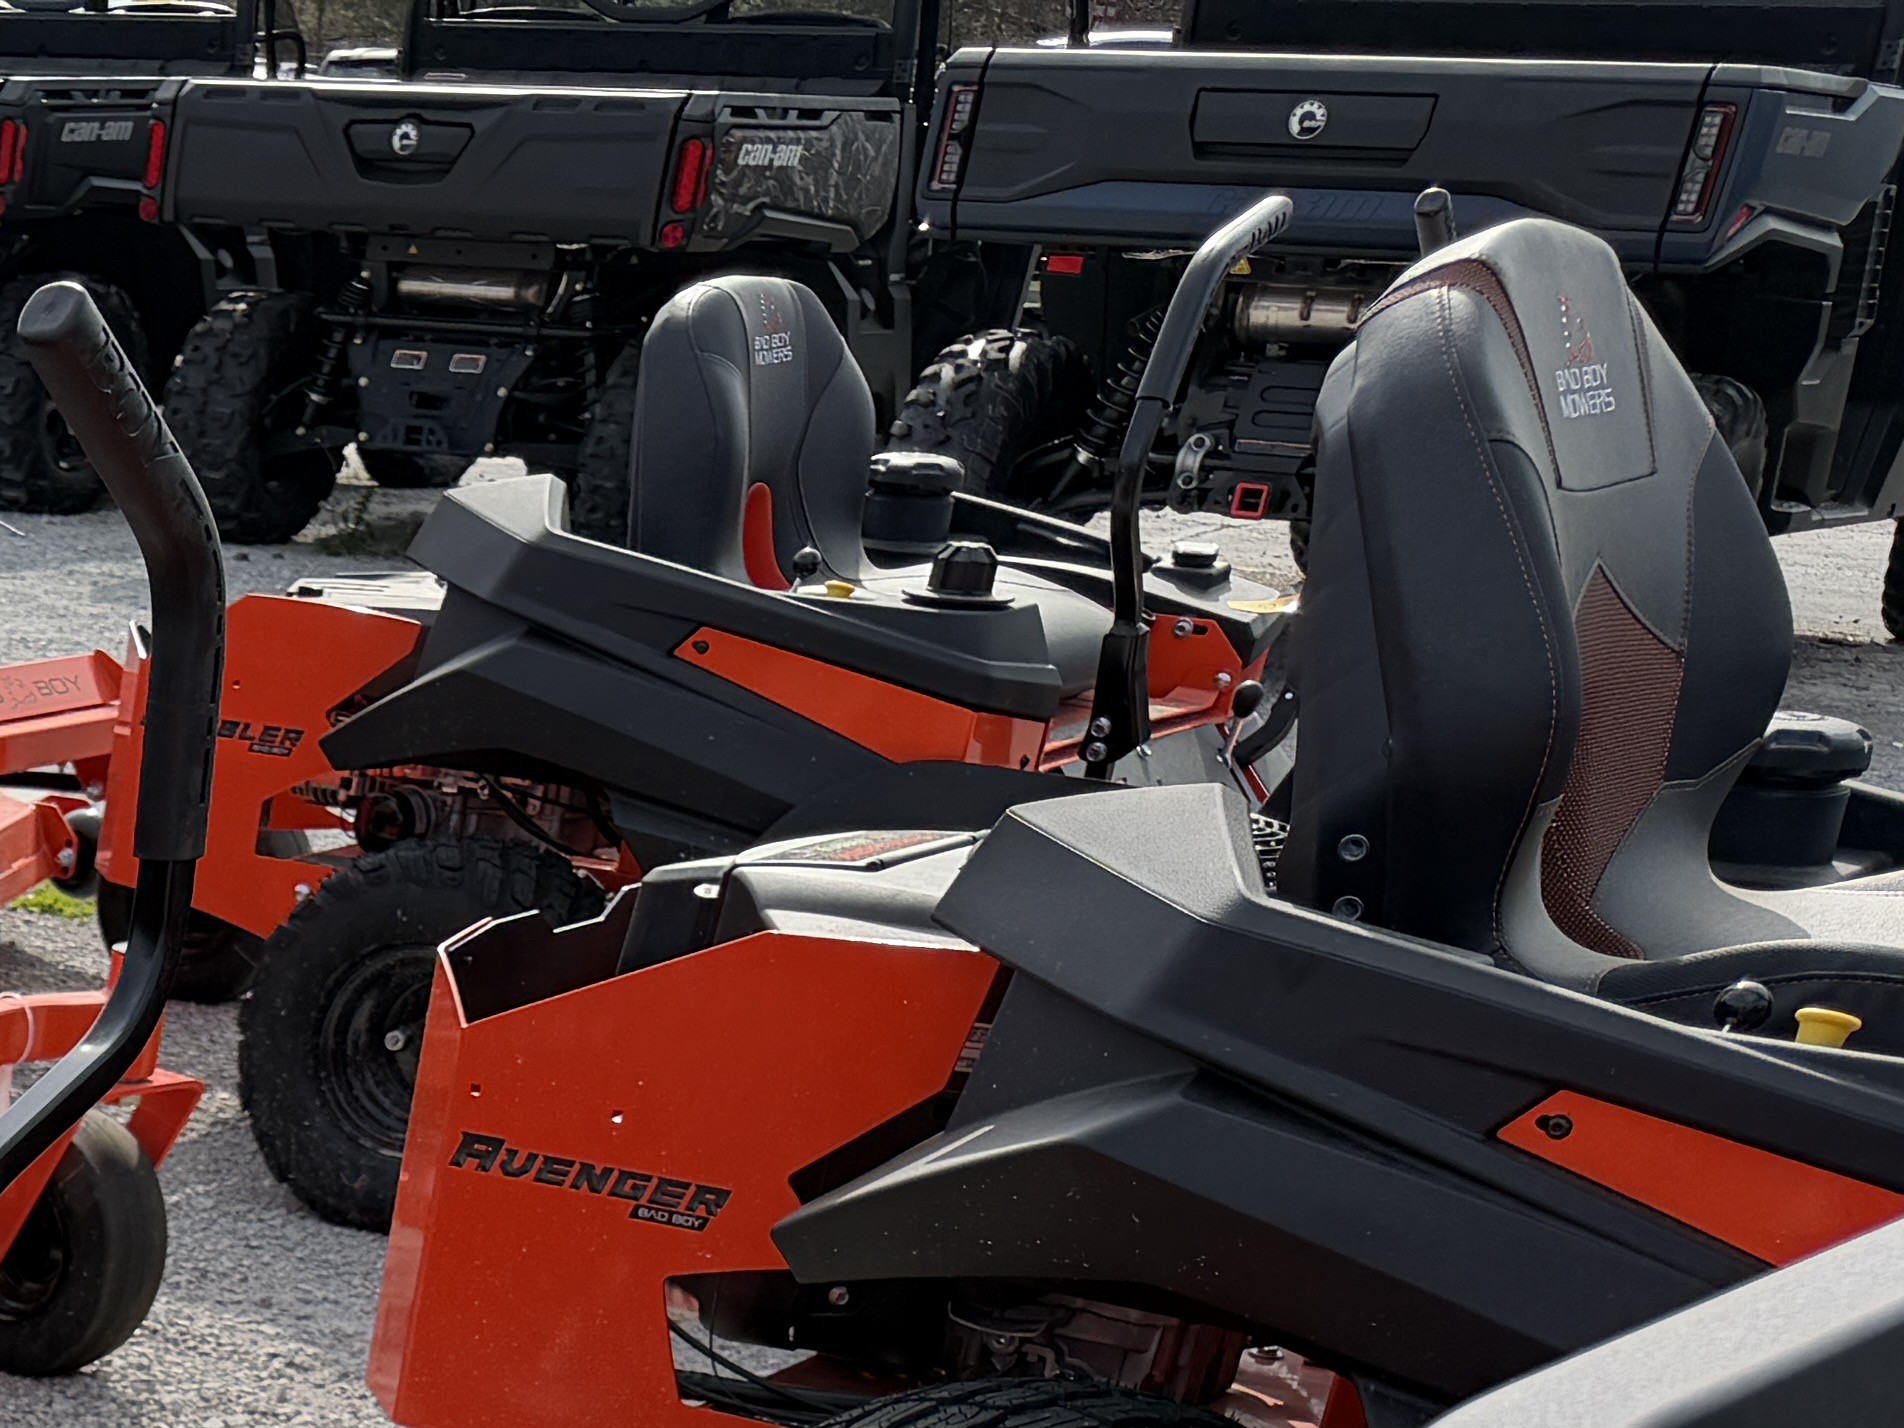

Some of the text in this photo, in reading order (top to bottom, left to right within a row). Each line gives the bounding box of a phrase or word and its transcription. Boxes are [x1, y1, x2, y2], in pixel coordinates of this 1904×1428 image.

[60, 121, 134, 142] can-am
[737, 143, 803, 167] can-am
[1582, 363, 1608, 387] BOY
[36, 674, 84, 698] BOY
[448, 1131, 733, 1217] AVENGER
[637, 1206, 703, 1228] BAD BOY
